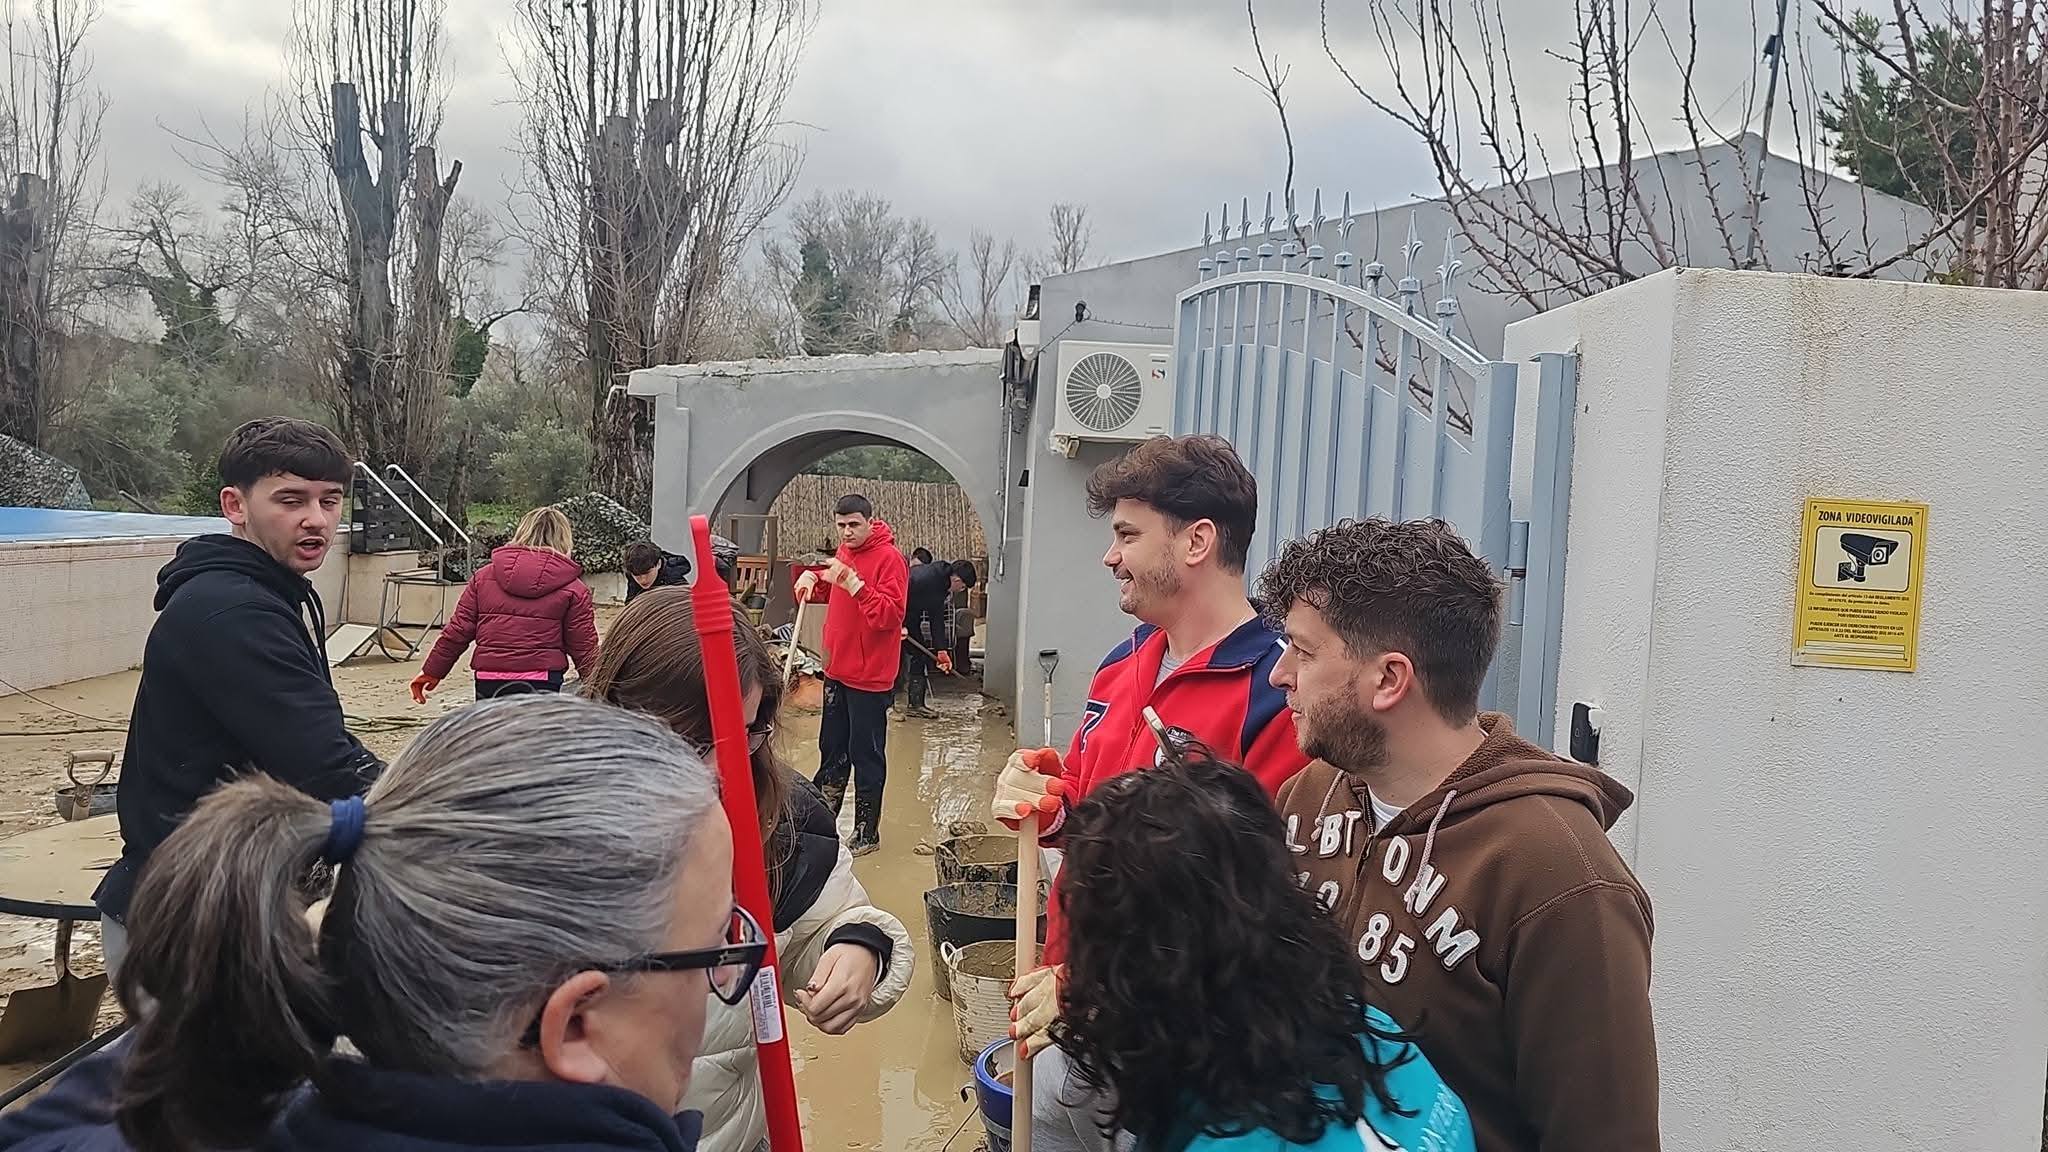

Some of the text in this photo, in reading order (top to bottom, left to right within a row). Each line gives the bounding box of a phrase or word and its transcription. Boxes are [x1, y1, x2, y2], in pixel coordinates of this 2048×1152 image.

[1818, 511, 1914, 526] ZONA VIDEOVIGILADA
[1080, 699, 1111, 753] 7
